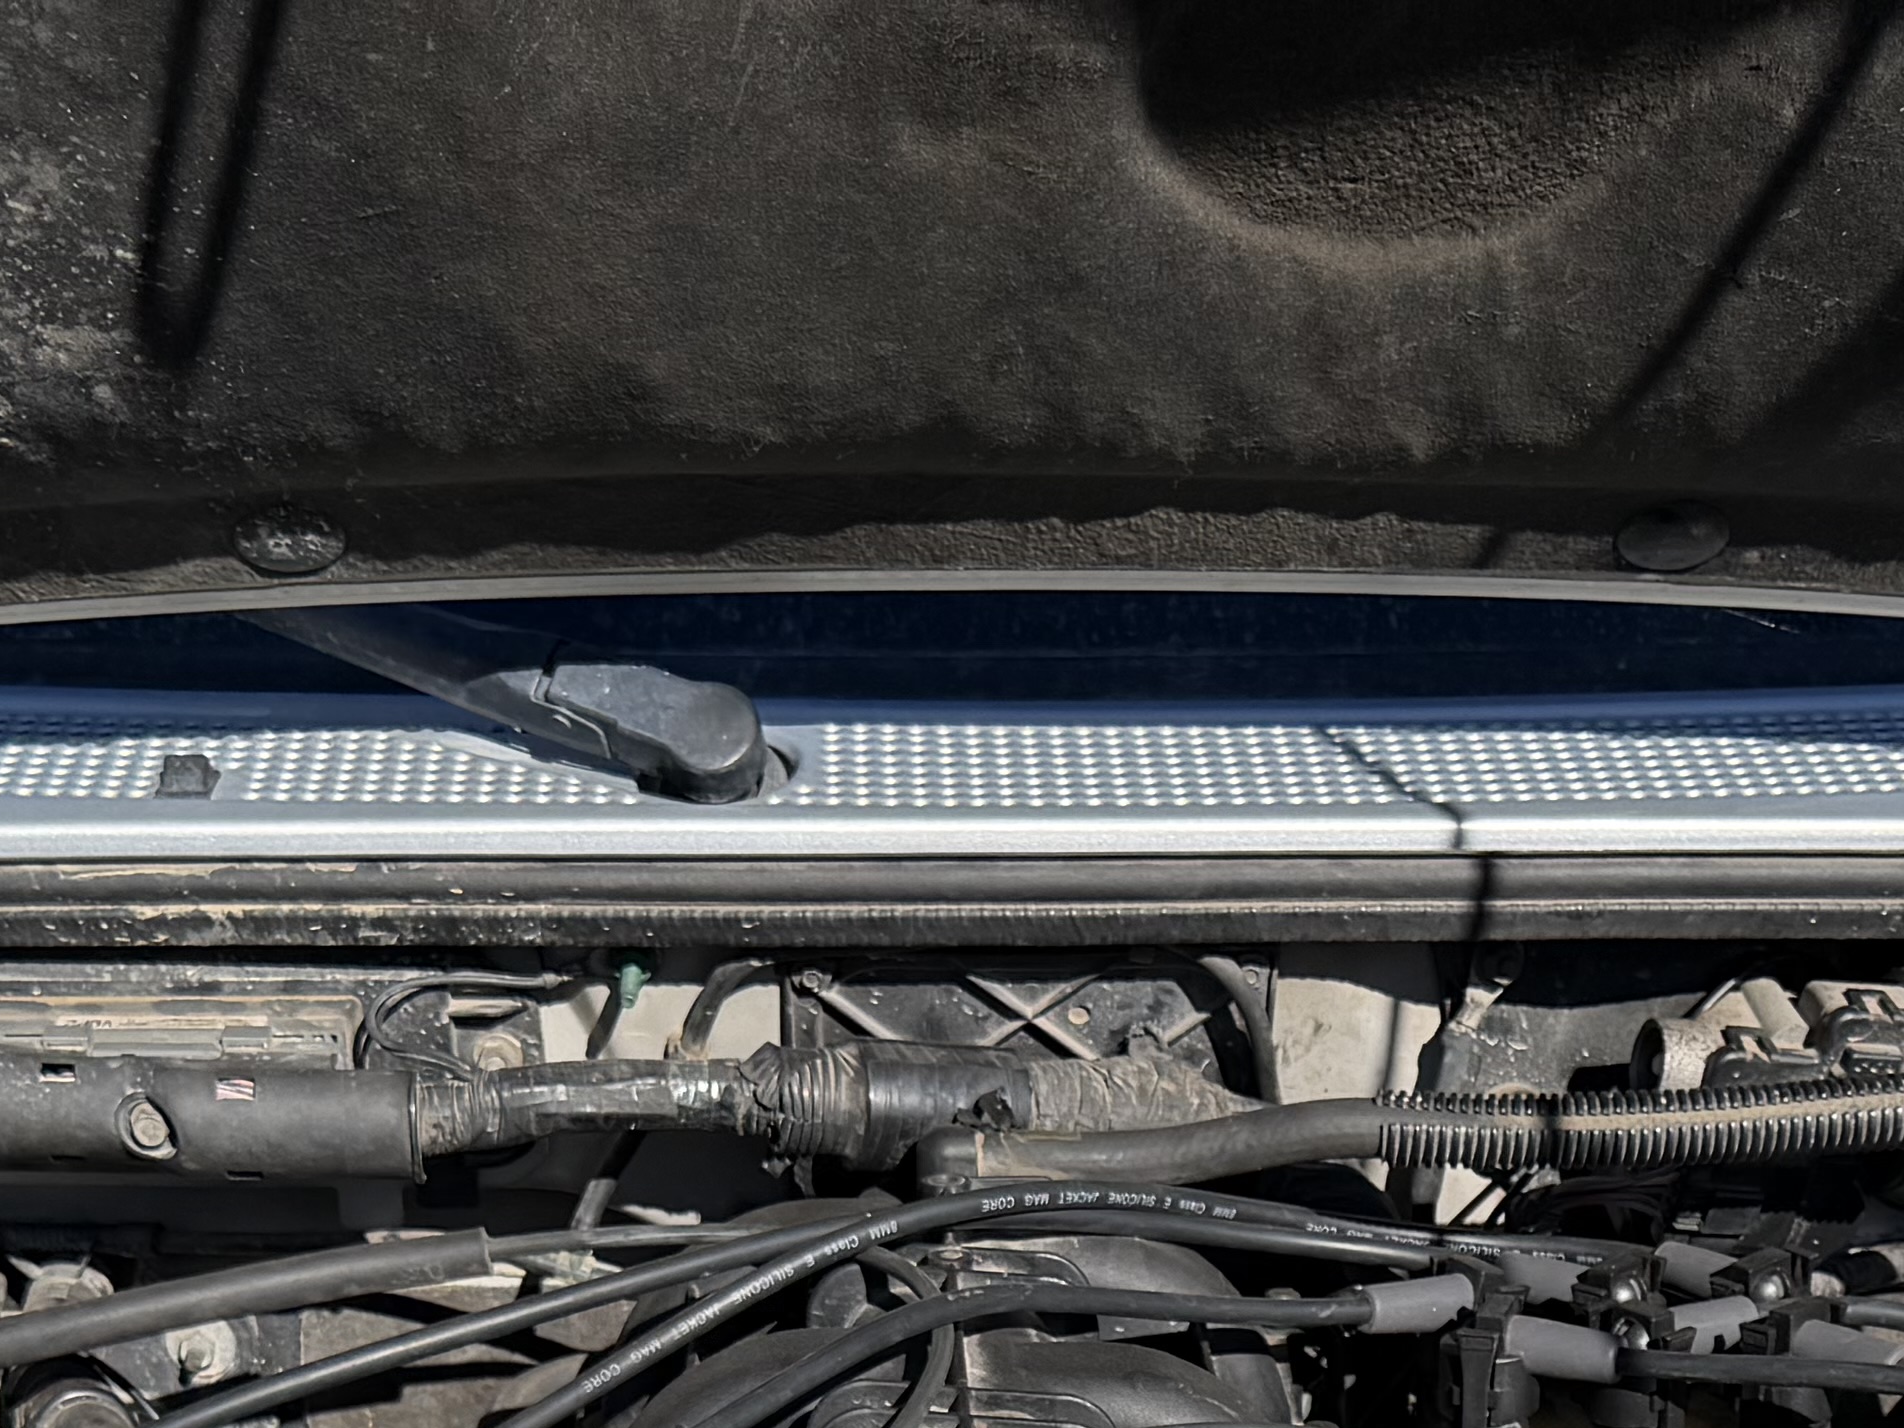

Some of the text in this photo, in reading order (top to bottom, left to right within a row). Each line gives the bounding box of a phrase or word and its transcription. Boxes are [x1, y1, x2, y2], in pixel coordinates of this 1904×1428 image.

[982, 1198, 1015, 1212] CORE
[1024, 1193, 1049, 1206] MAG
[1058, 1192, 1099, 1204] JACKET
[825, 1235, 859, 1256] Class
[806, 1254, 815, 1267] E
[733, 1267, 795, 1305] SILICONE
[672, 1305, 721, 1341] JACKET
[630, 1338, 662, 1364] MAG
[582, 1363, 621, 1393] CORE
